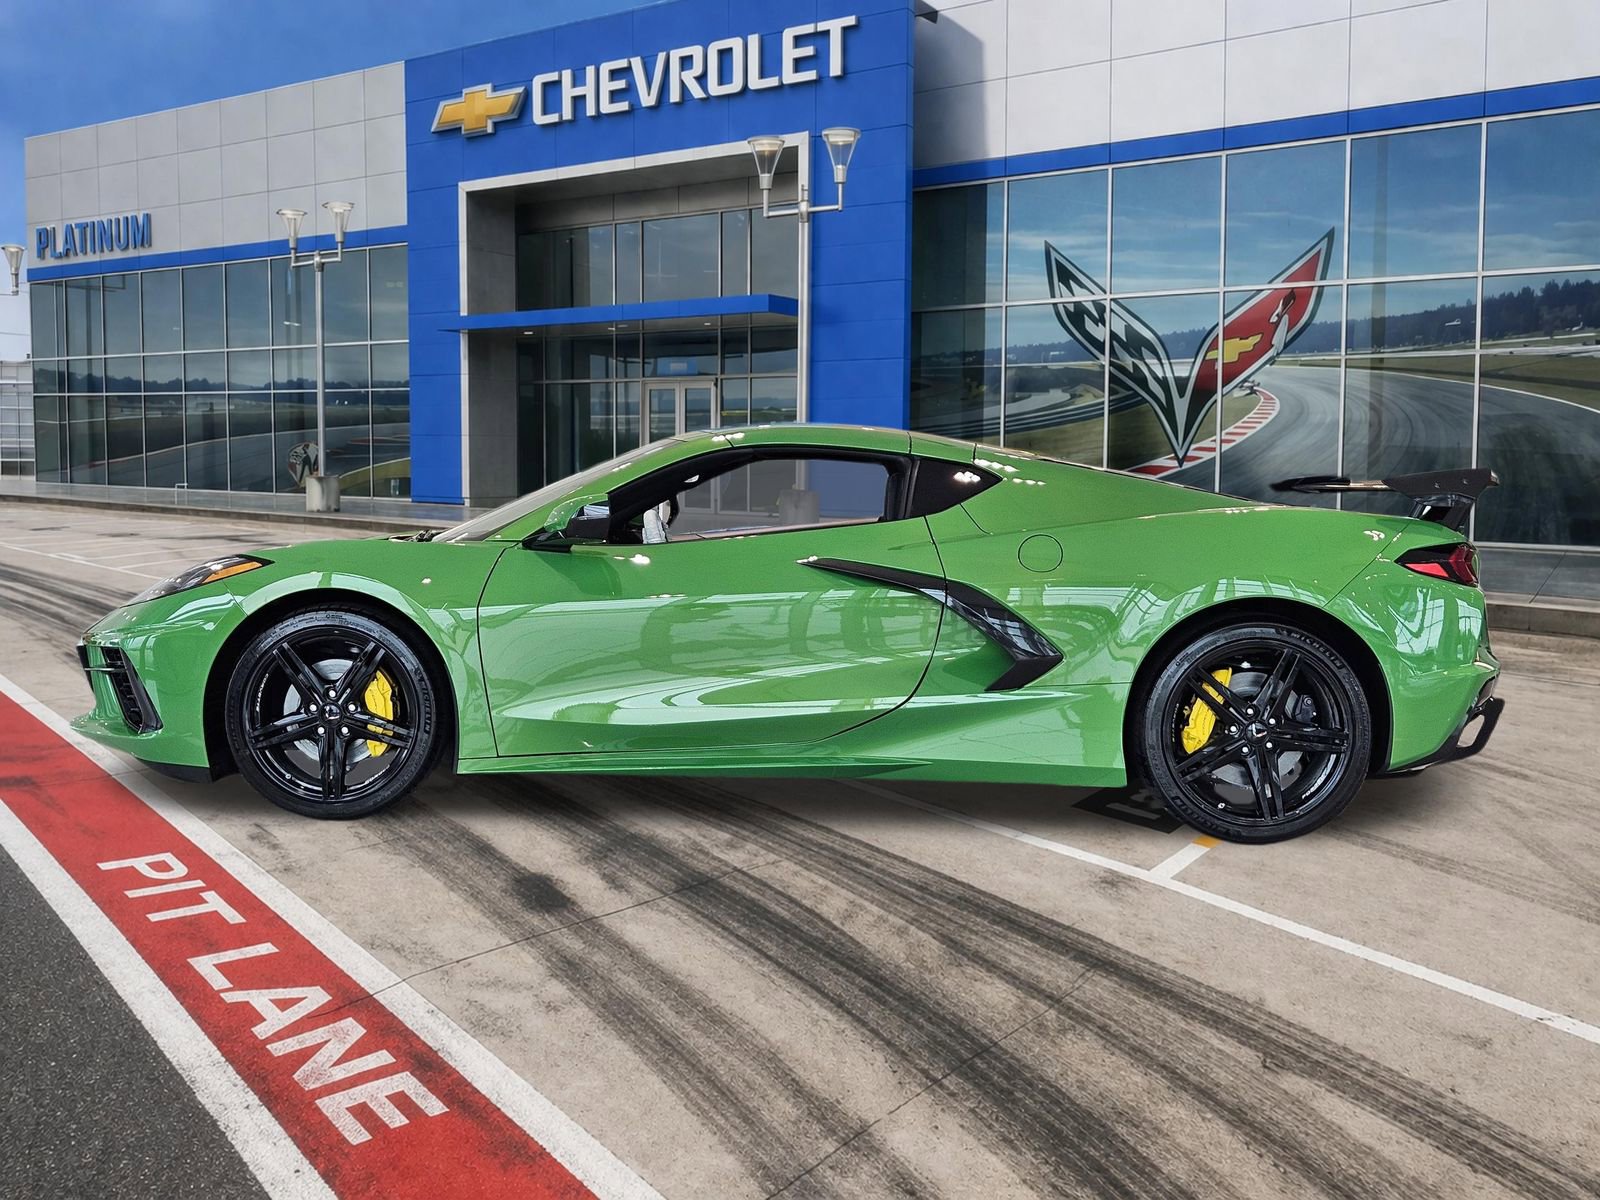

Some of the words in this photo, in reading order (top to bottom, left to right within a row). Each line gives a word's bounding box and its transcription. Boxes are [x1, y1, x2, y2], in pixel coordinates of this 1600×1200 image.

[532, 15, 858, 126] CHEVROLET
[36, 213, 152, 260] PLATINUM
[1290, 632, 1342, 668] MICHELIN
[96, 852, 247, 924] PIT
[186, 942, 450, 1146] LANE
